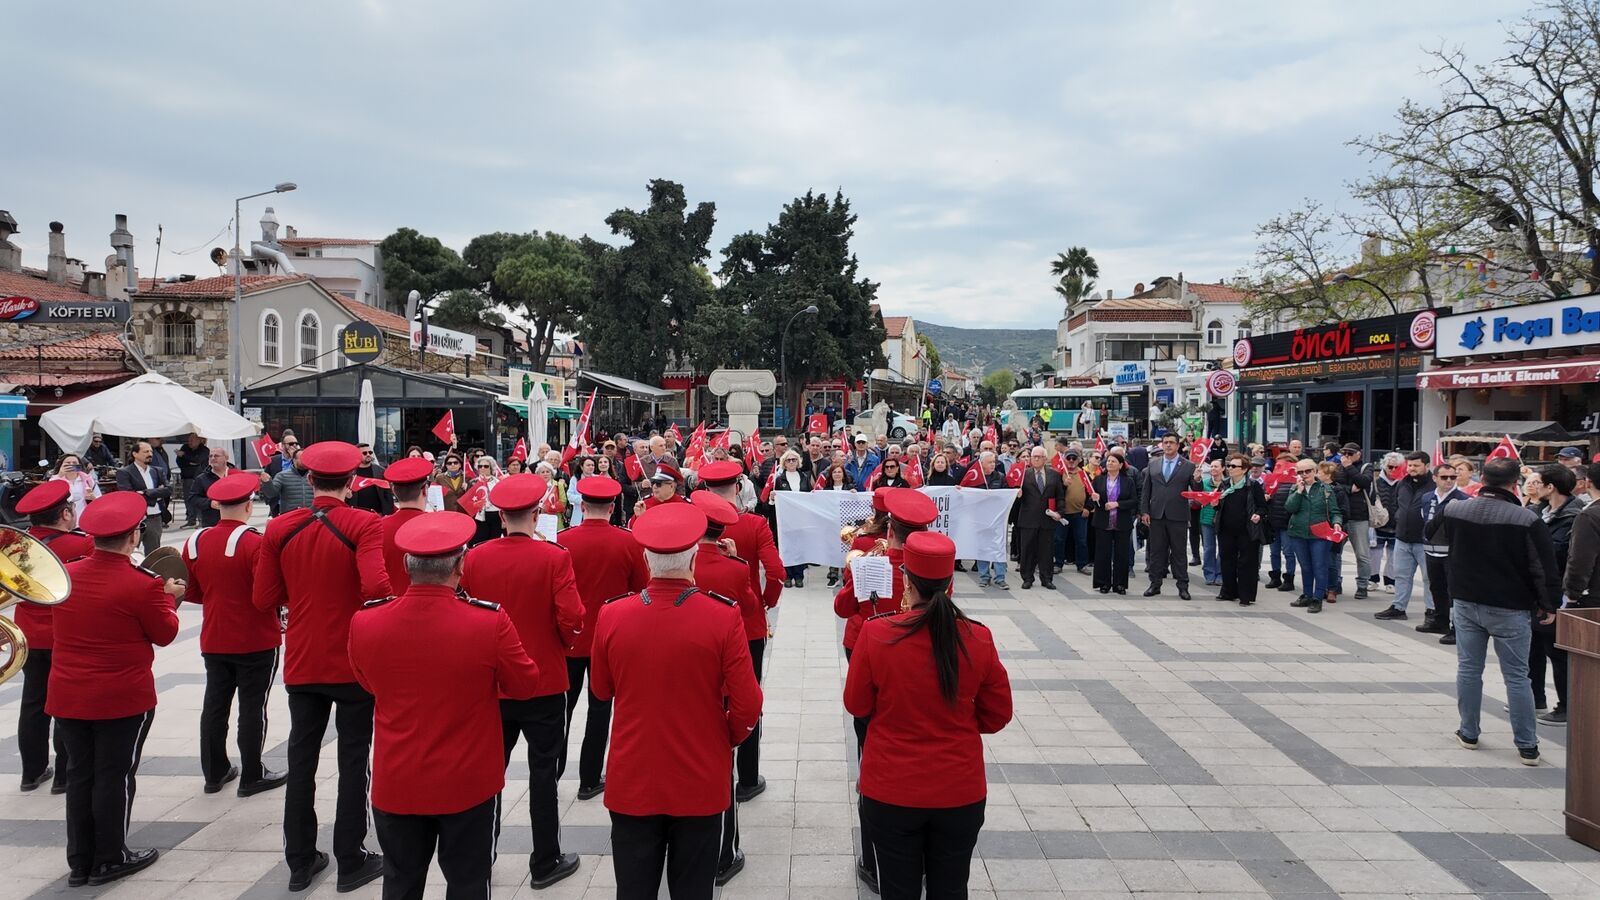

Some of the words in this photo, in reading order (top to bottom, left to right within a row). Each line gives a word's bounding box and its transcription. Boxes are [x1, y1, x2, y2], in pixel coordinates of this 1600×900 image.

[48, 305, 92, 318] KÖFTE
[95, 305, 116, 318] EVİ
[1493, 316, 1553, 345] Foça
[1369, 333, 1390, 345] FOÇA
[1452, 374, 1479, 387] Foça
[1481, 371, 1513, 384] Balık
[1515, 369, 1560, 382] Ekmek
